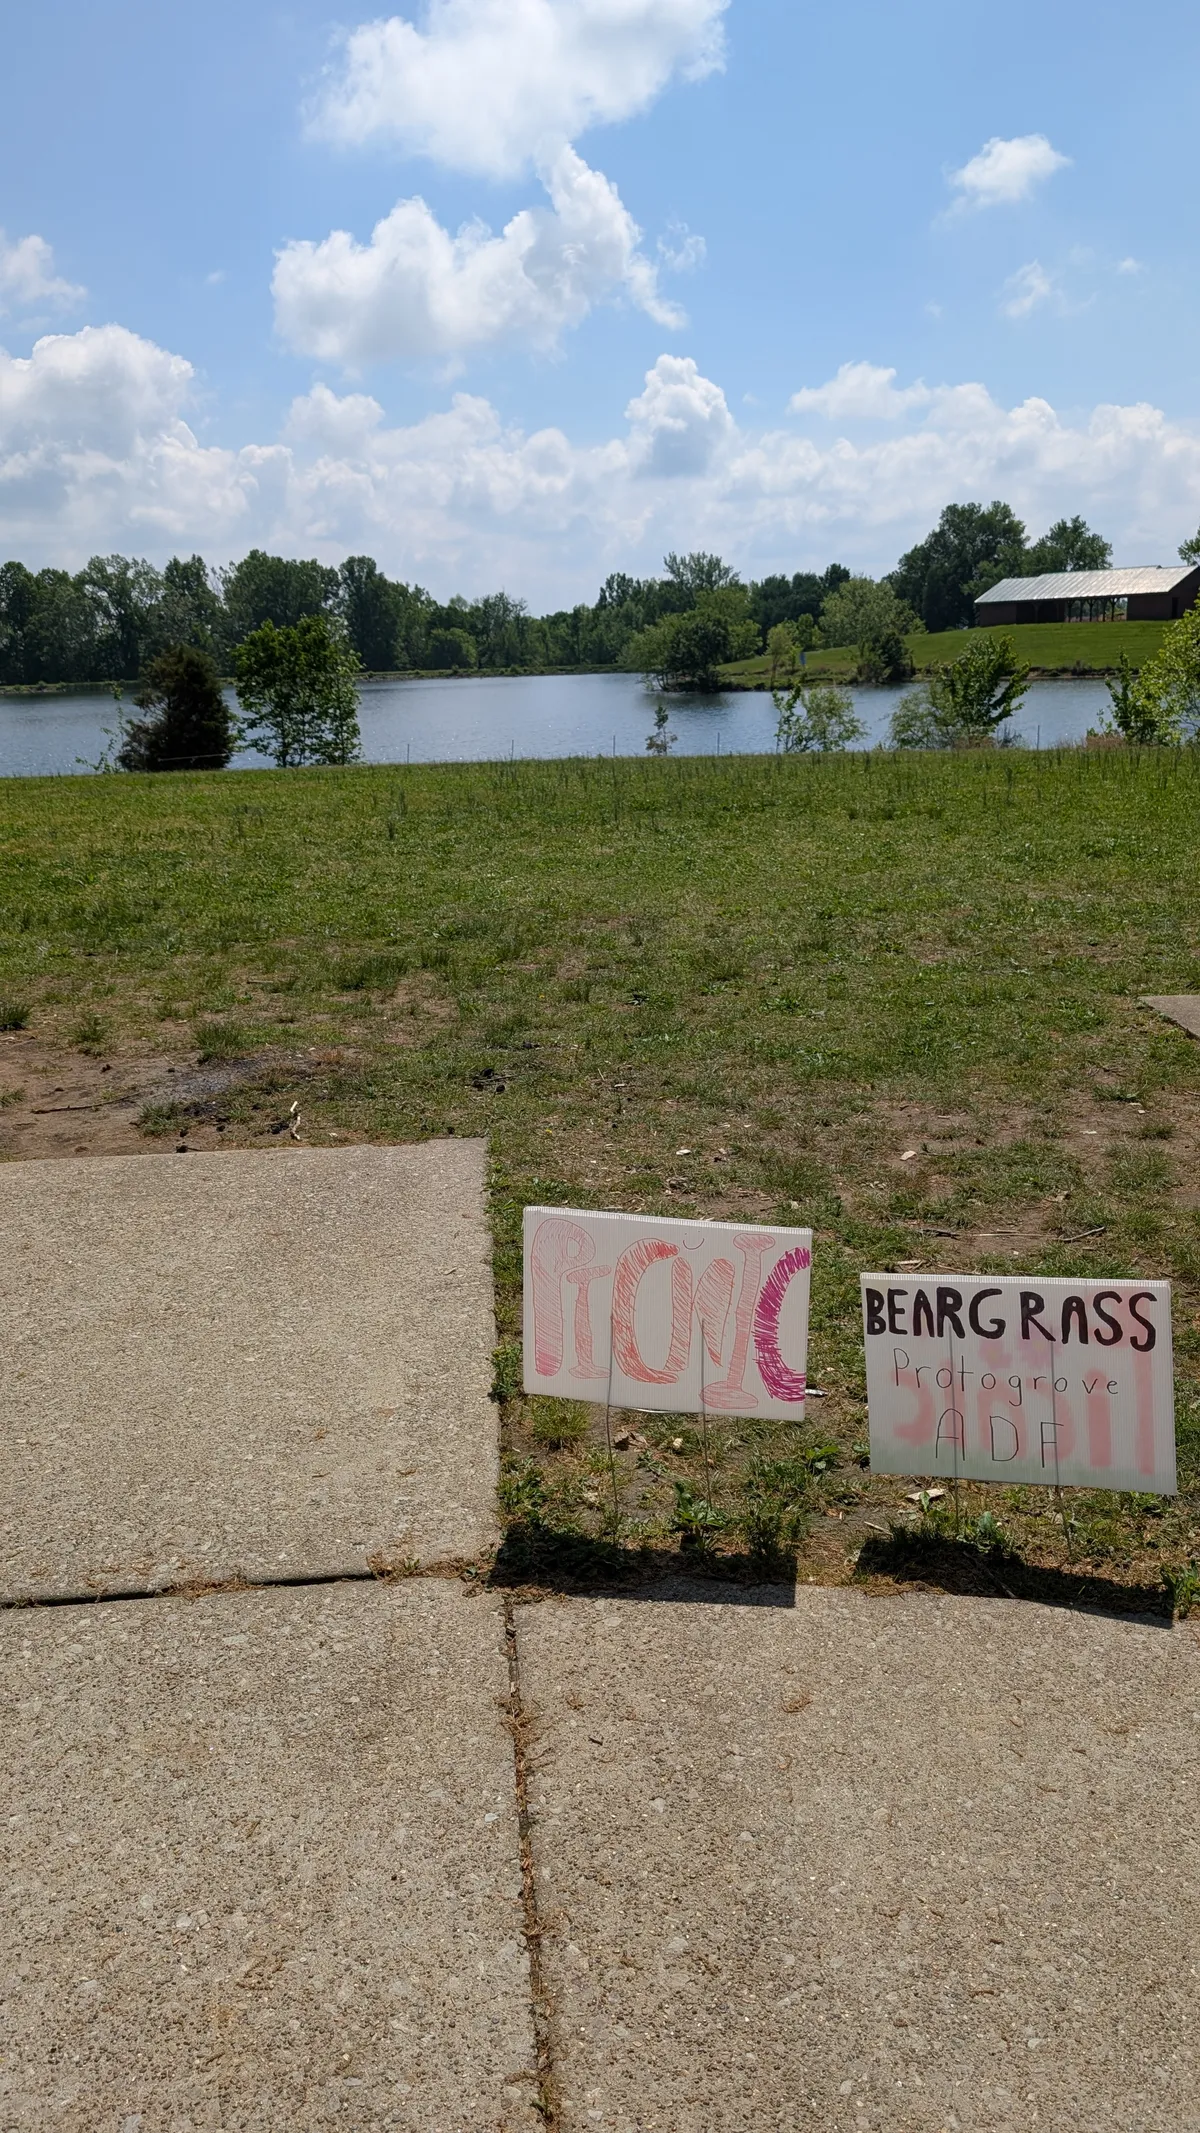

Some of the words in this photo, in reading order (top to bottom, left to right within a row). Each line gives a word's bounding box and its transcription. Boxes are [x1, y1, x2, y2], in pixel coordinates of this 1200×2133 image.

[865, 1286, 1158, 1352] BEARGRASS
[892, 1347, 1119, 1407] Protogrove
[934, 1407, 1065, 1468] ADF
